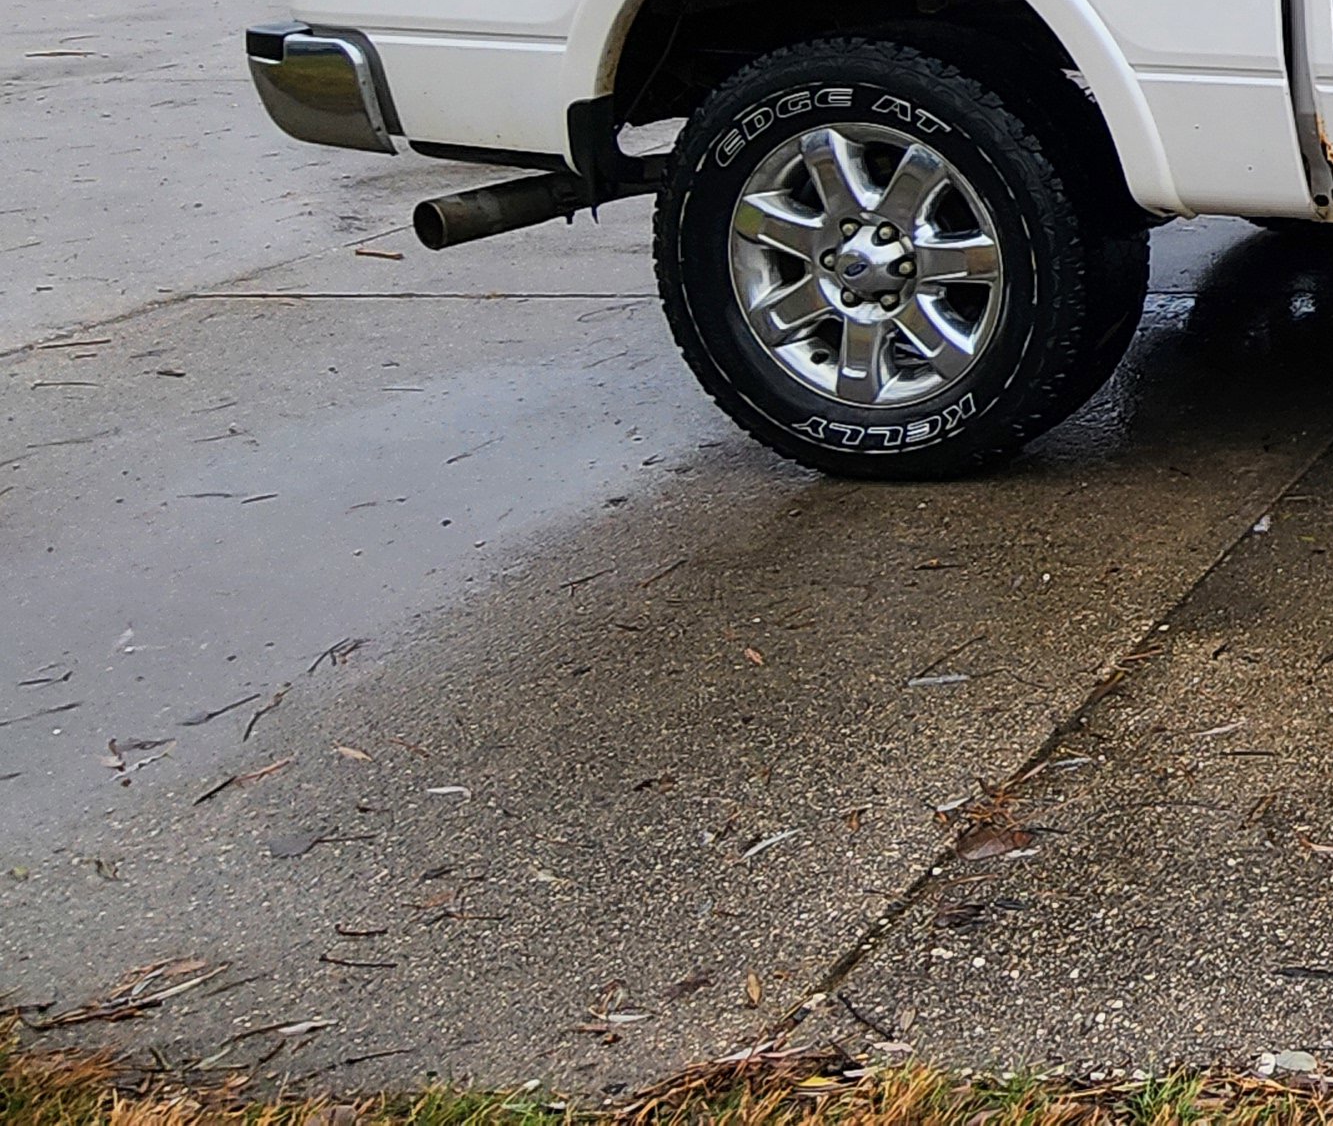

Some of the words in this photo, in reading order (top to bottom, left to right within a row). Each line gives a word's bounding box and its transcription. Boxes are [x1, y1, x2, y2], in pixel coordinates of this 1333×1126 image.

[714, 88, 853, 167] EDGE
[871, 94, 952, 135] AT
[792, 392, 977, 447] KELLY
